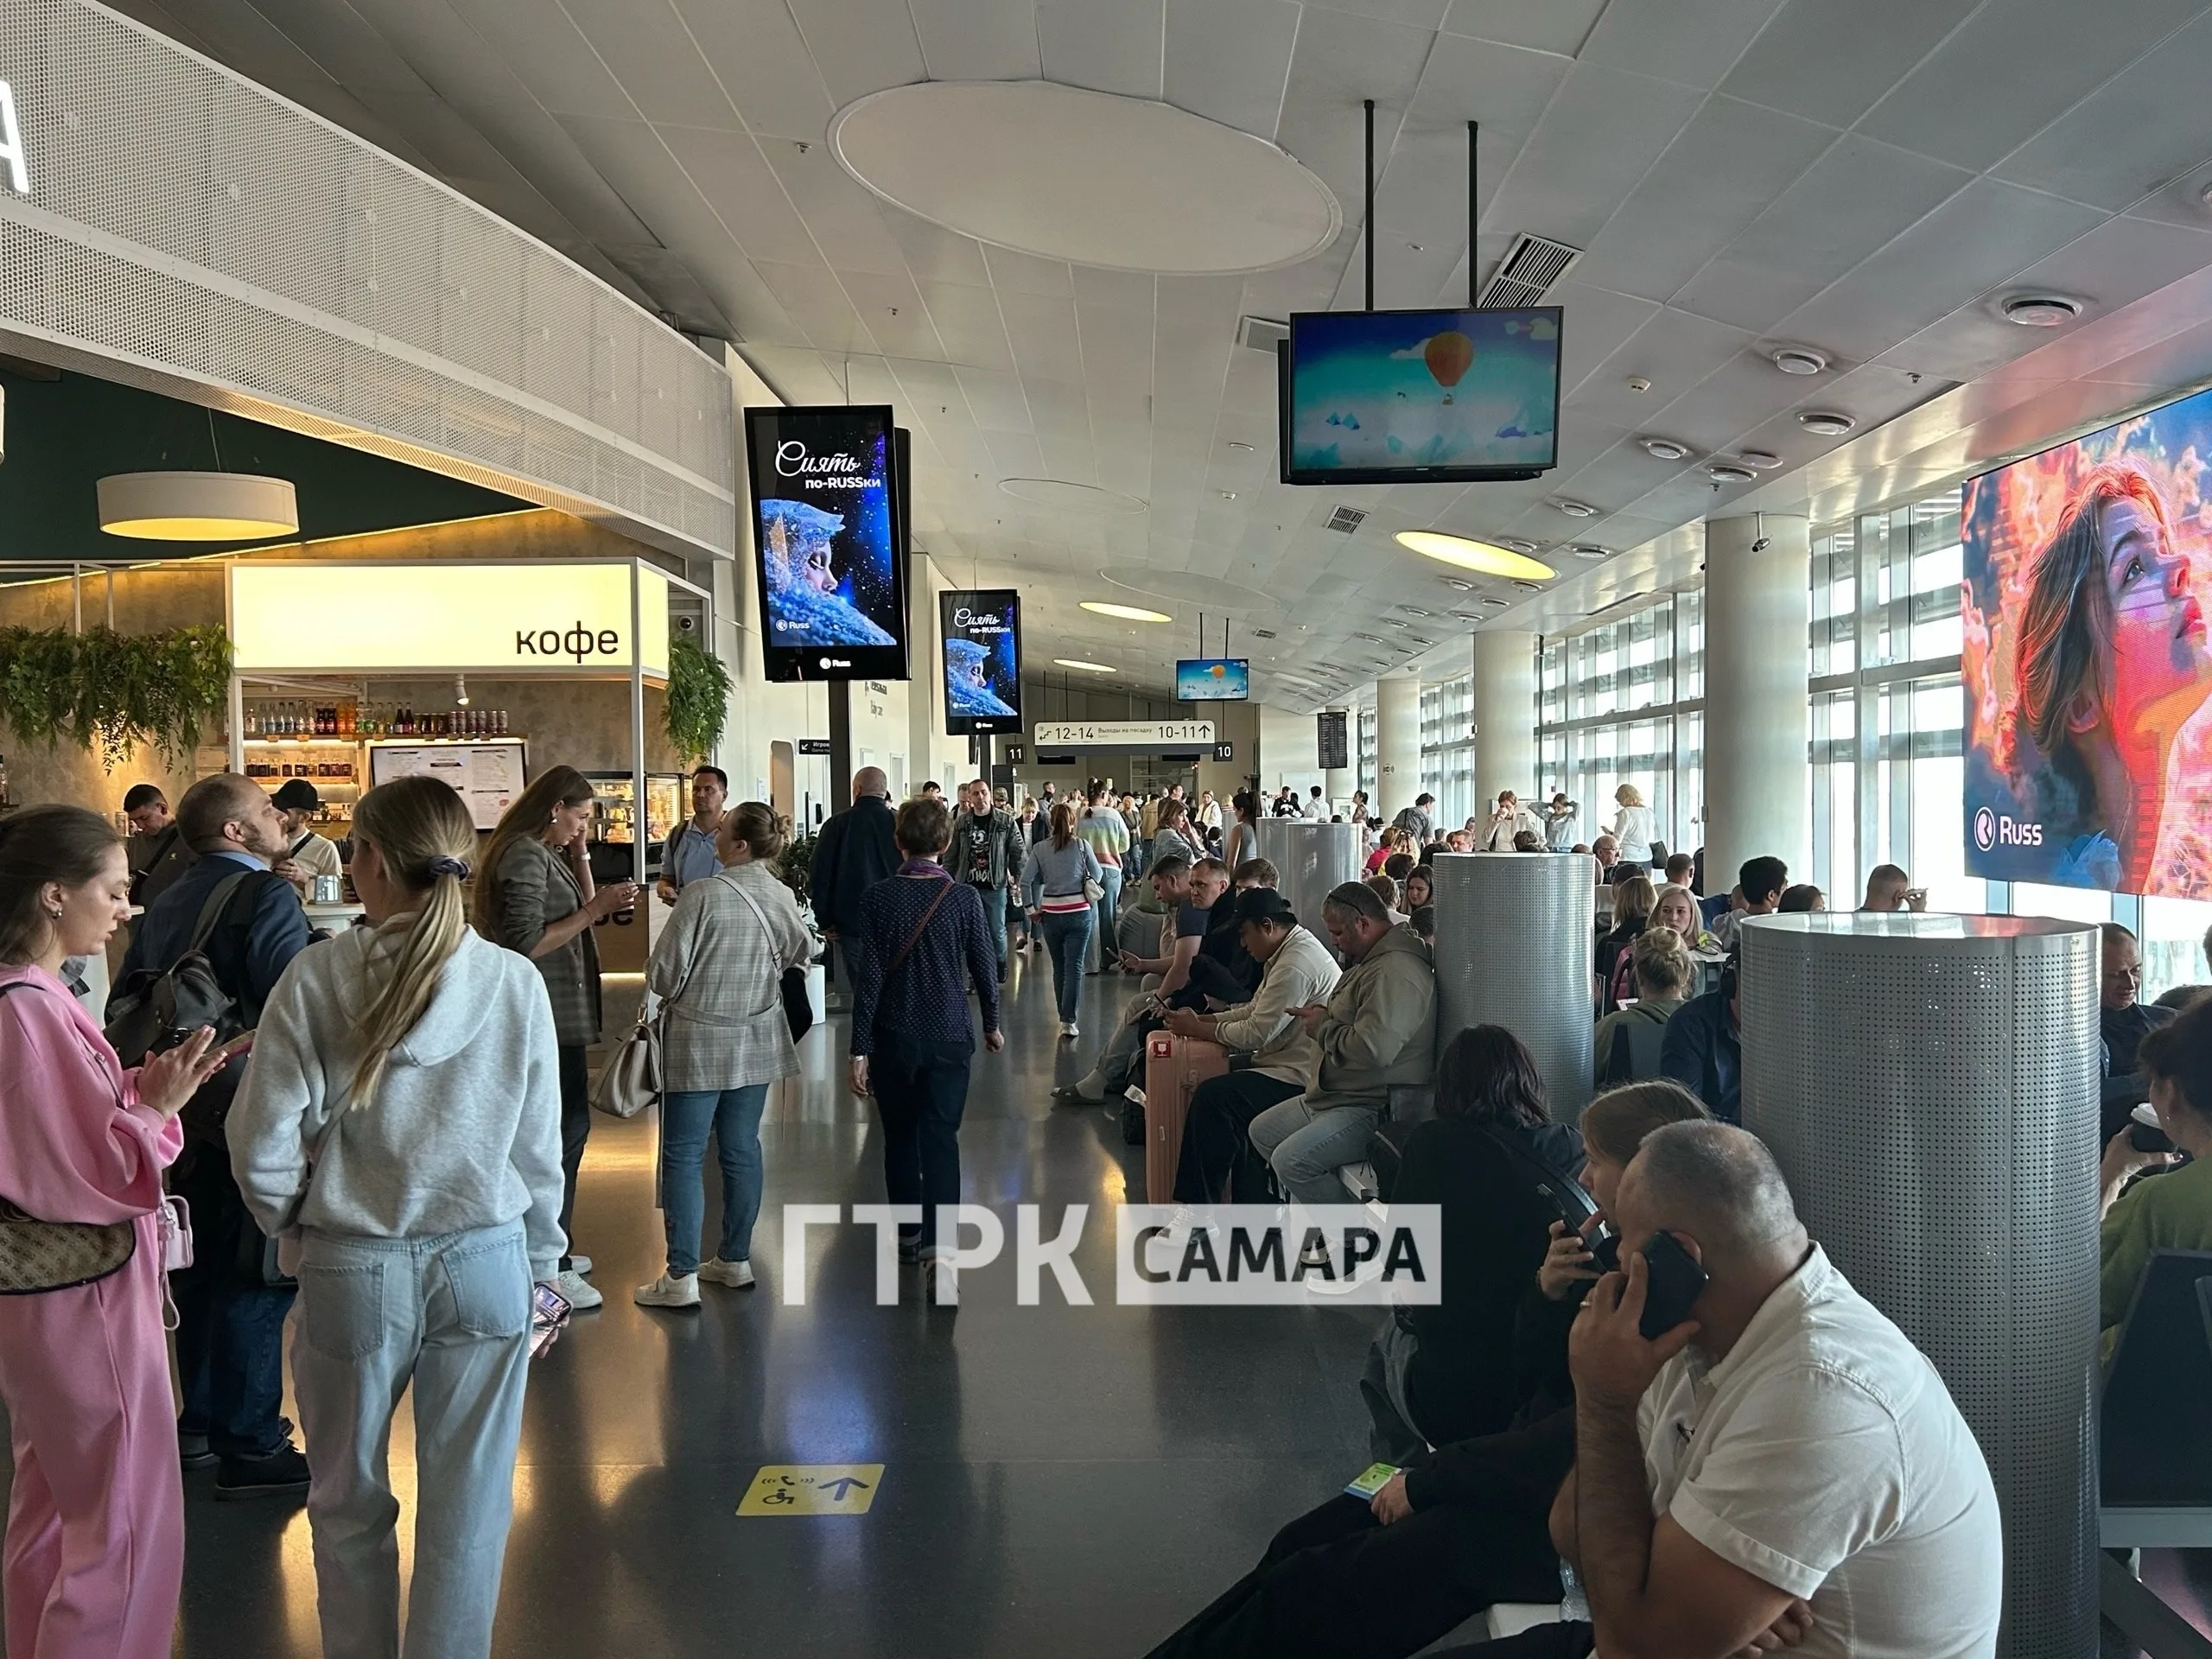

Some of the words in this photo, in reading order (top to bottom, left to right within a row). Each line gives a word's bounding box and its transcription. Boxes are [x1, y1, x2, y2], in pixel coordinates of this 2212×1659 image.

[775, 440, 861, 477] Сиять
[804, 476, 881, 489] по-RUSSки
[954, 607, 1000, 628] Сиять
[516, 620, 619, 664] кофе
[1055, 727, 1094, 740] 12-14
[1158, 726, 1195, 739] 10-11
[1009, 747, 1022, 760] 11
[1217, 746, 1231, 758] 10
[1999, 815, 2043, 846] Russ
